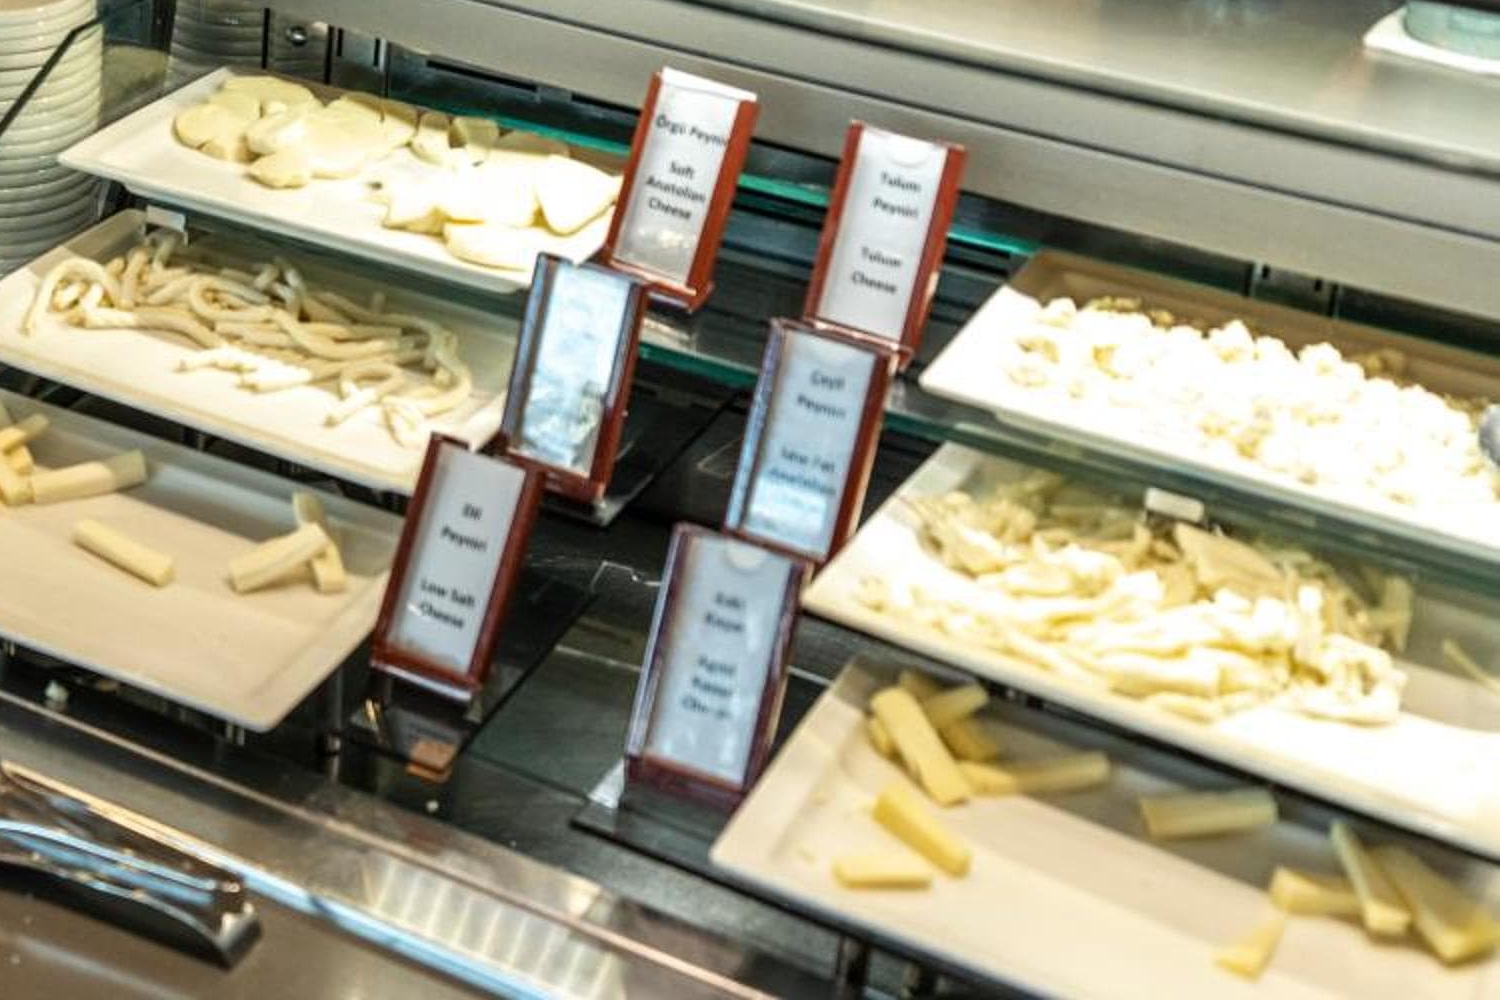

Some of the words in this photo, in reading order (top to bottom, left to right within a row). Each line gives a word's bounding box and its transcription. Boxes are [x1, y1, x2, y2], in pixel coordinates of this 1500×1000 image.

[669, 160, 695, 179] Soft
[646, 176, 707, 203] Anatolian
[880, 171, 921, 192] Tulum
[649, 197, 692, 220] Cheese
[872, 197, 919, 220] Peyniri
[851, 271, 898, 294] Cheese
[441, 526, 487, 552] Peyniri
[420, 578, 448, 598] Low
[418, 603, 465, 629] Cheese
